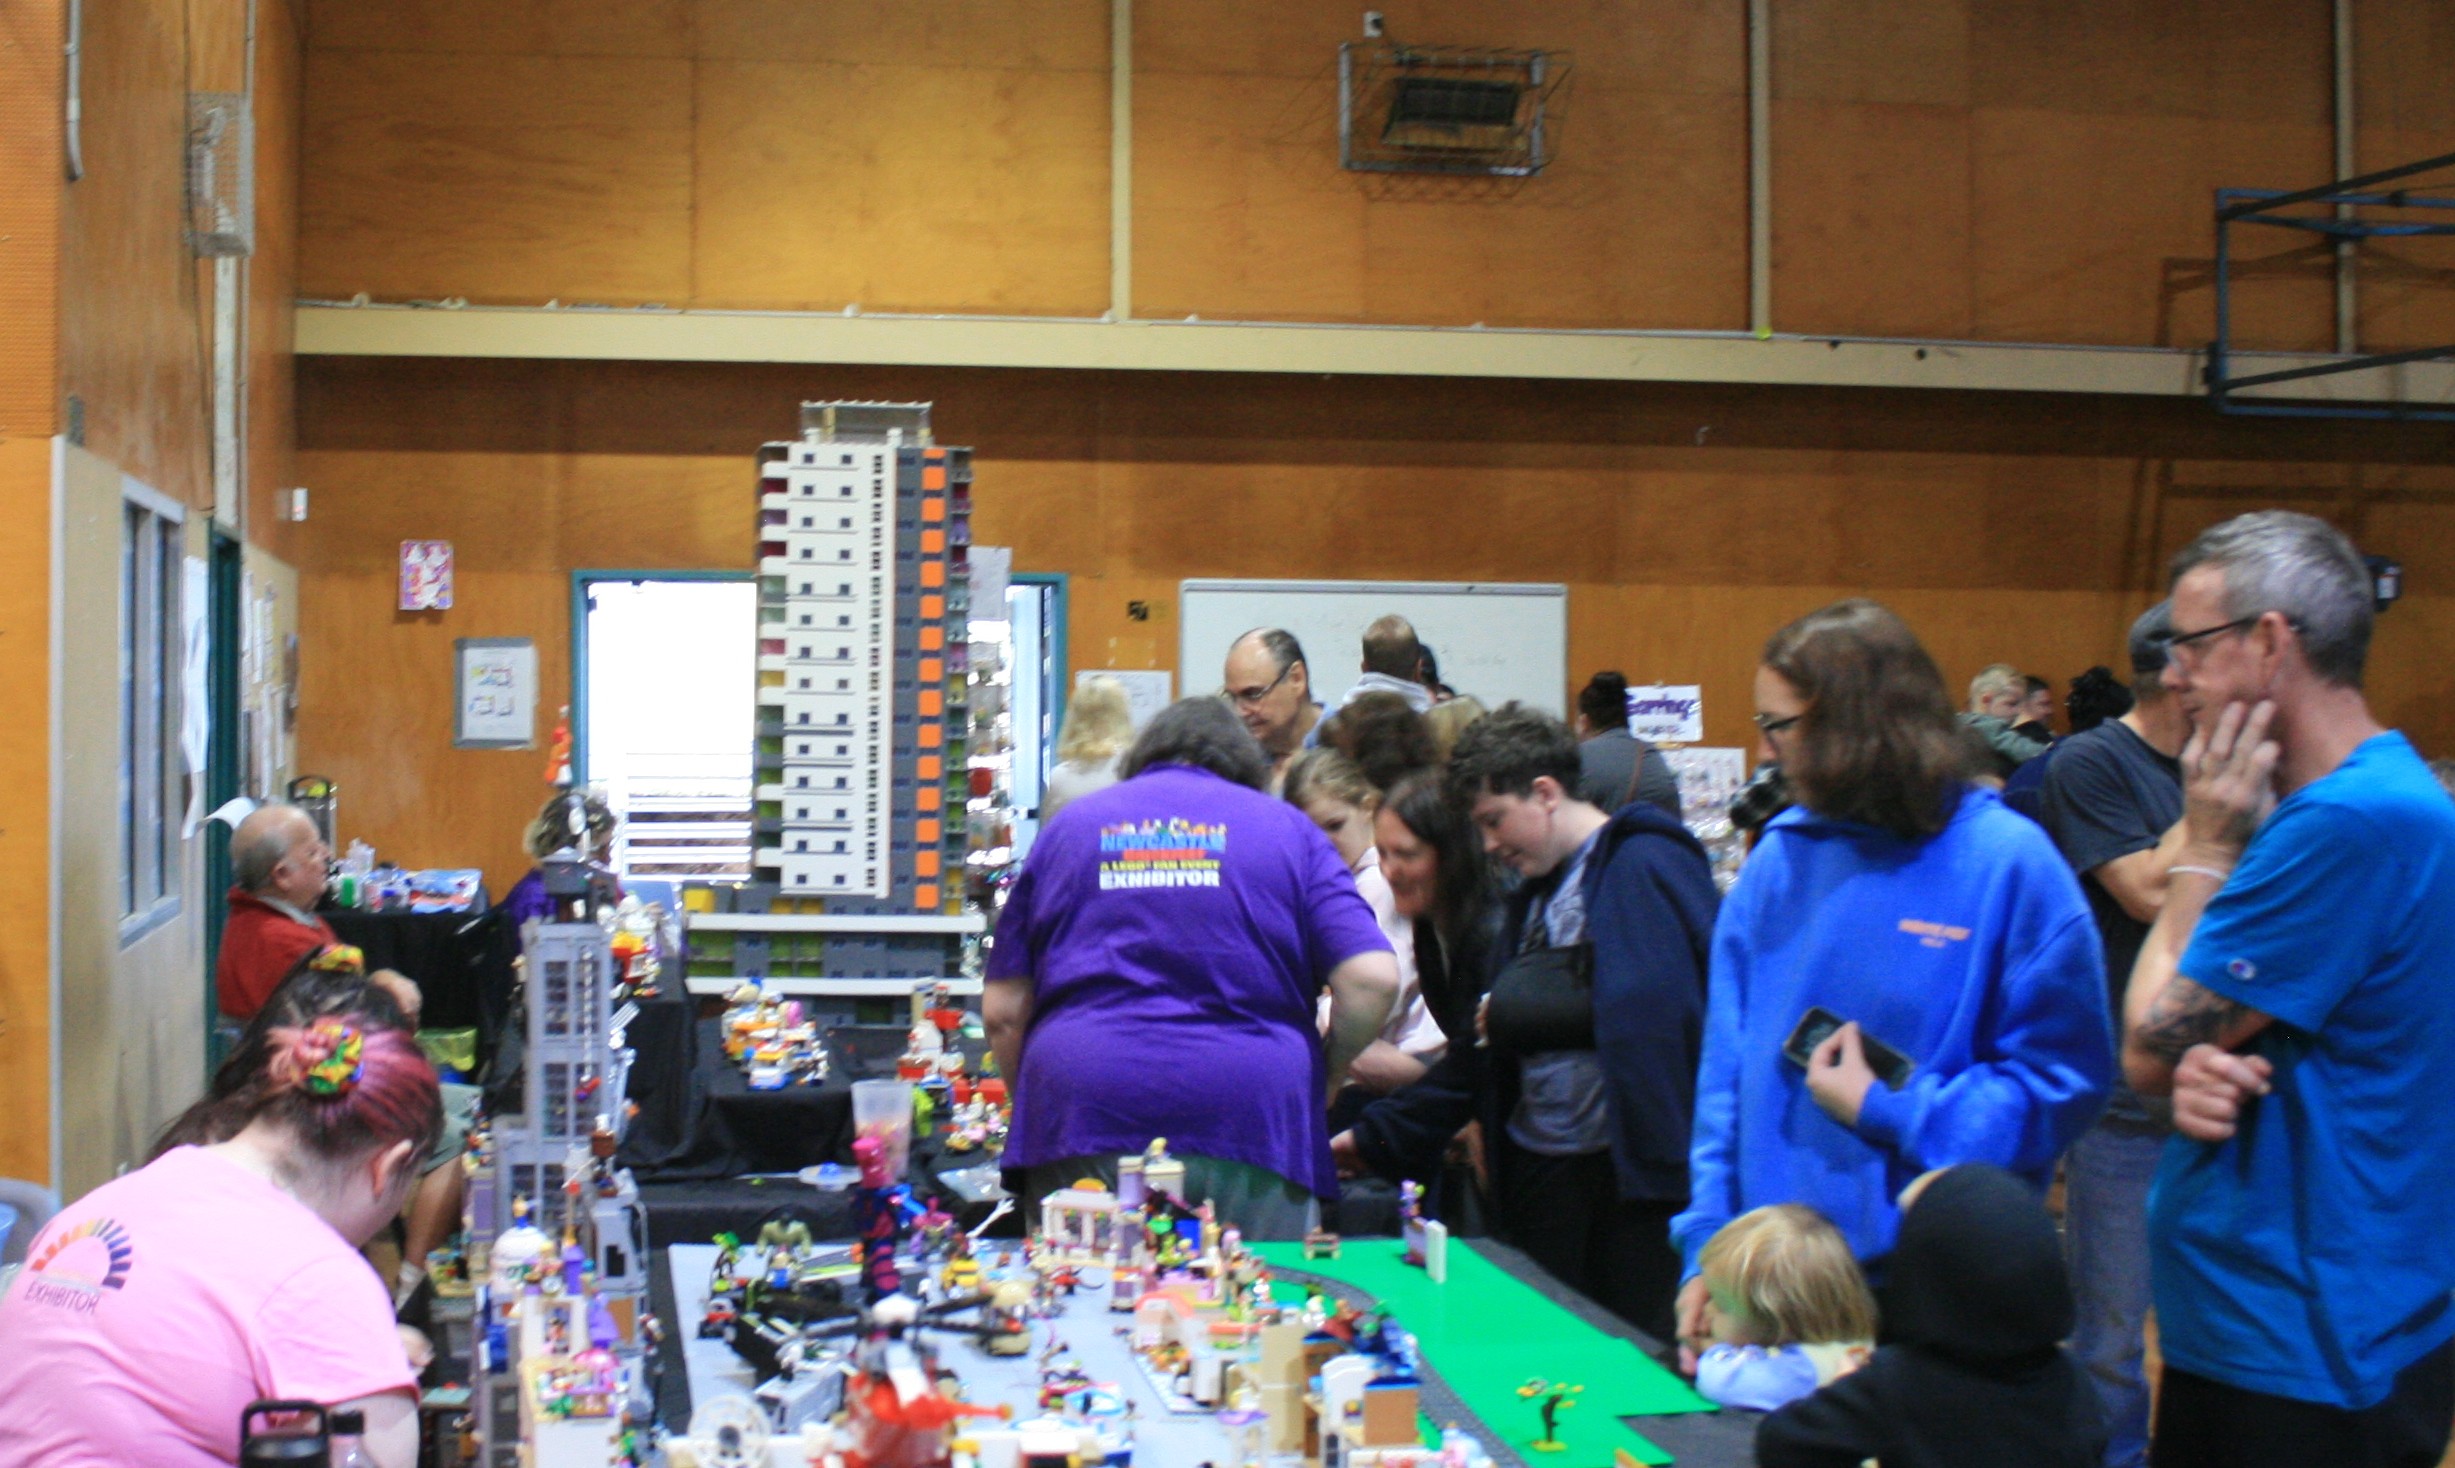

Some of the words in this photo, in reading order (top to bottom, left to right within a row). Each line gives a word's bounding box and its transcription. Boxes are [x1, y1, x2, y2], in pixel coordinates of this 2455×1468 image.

[1100, 833, 1227, 853] NEWCASTLE
[1099, 869, 1220, 890] EXHIBITOR
[24, 1280, 101, 1316] EXHIBITOR
